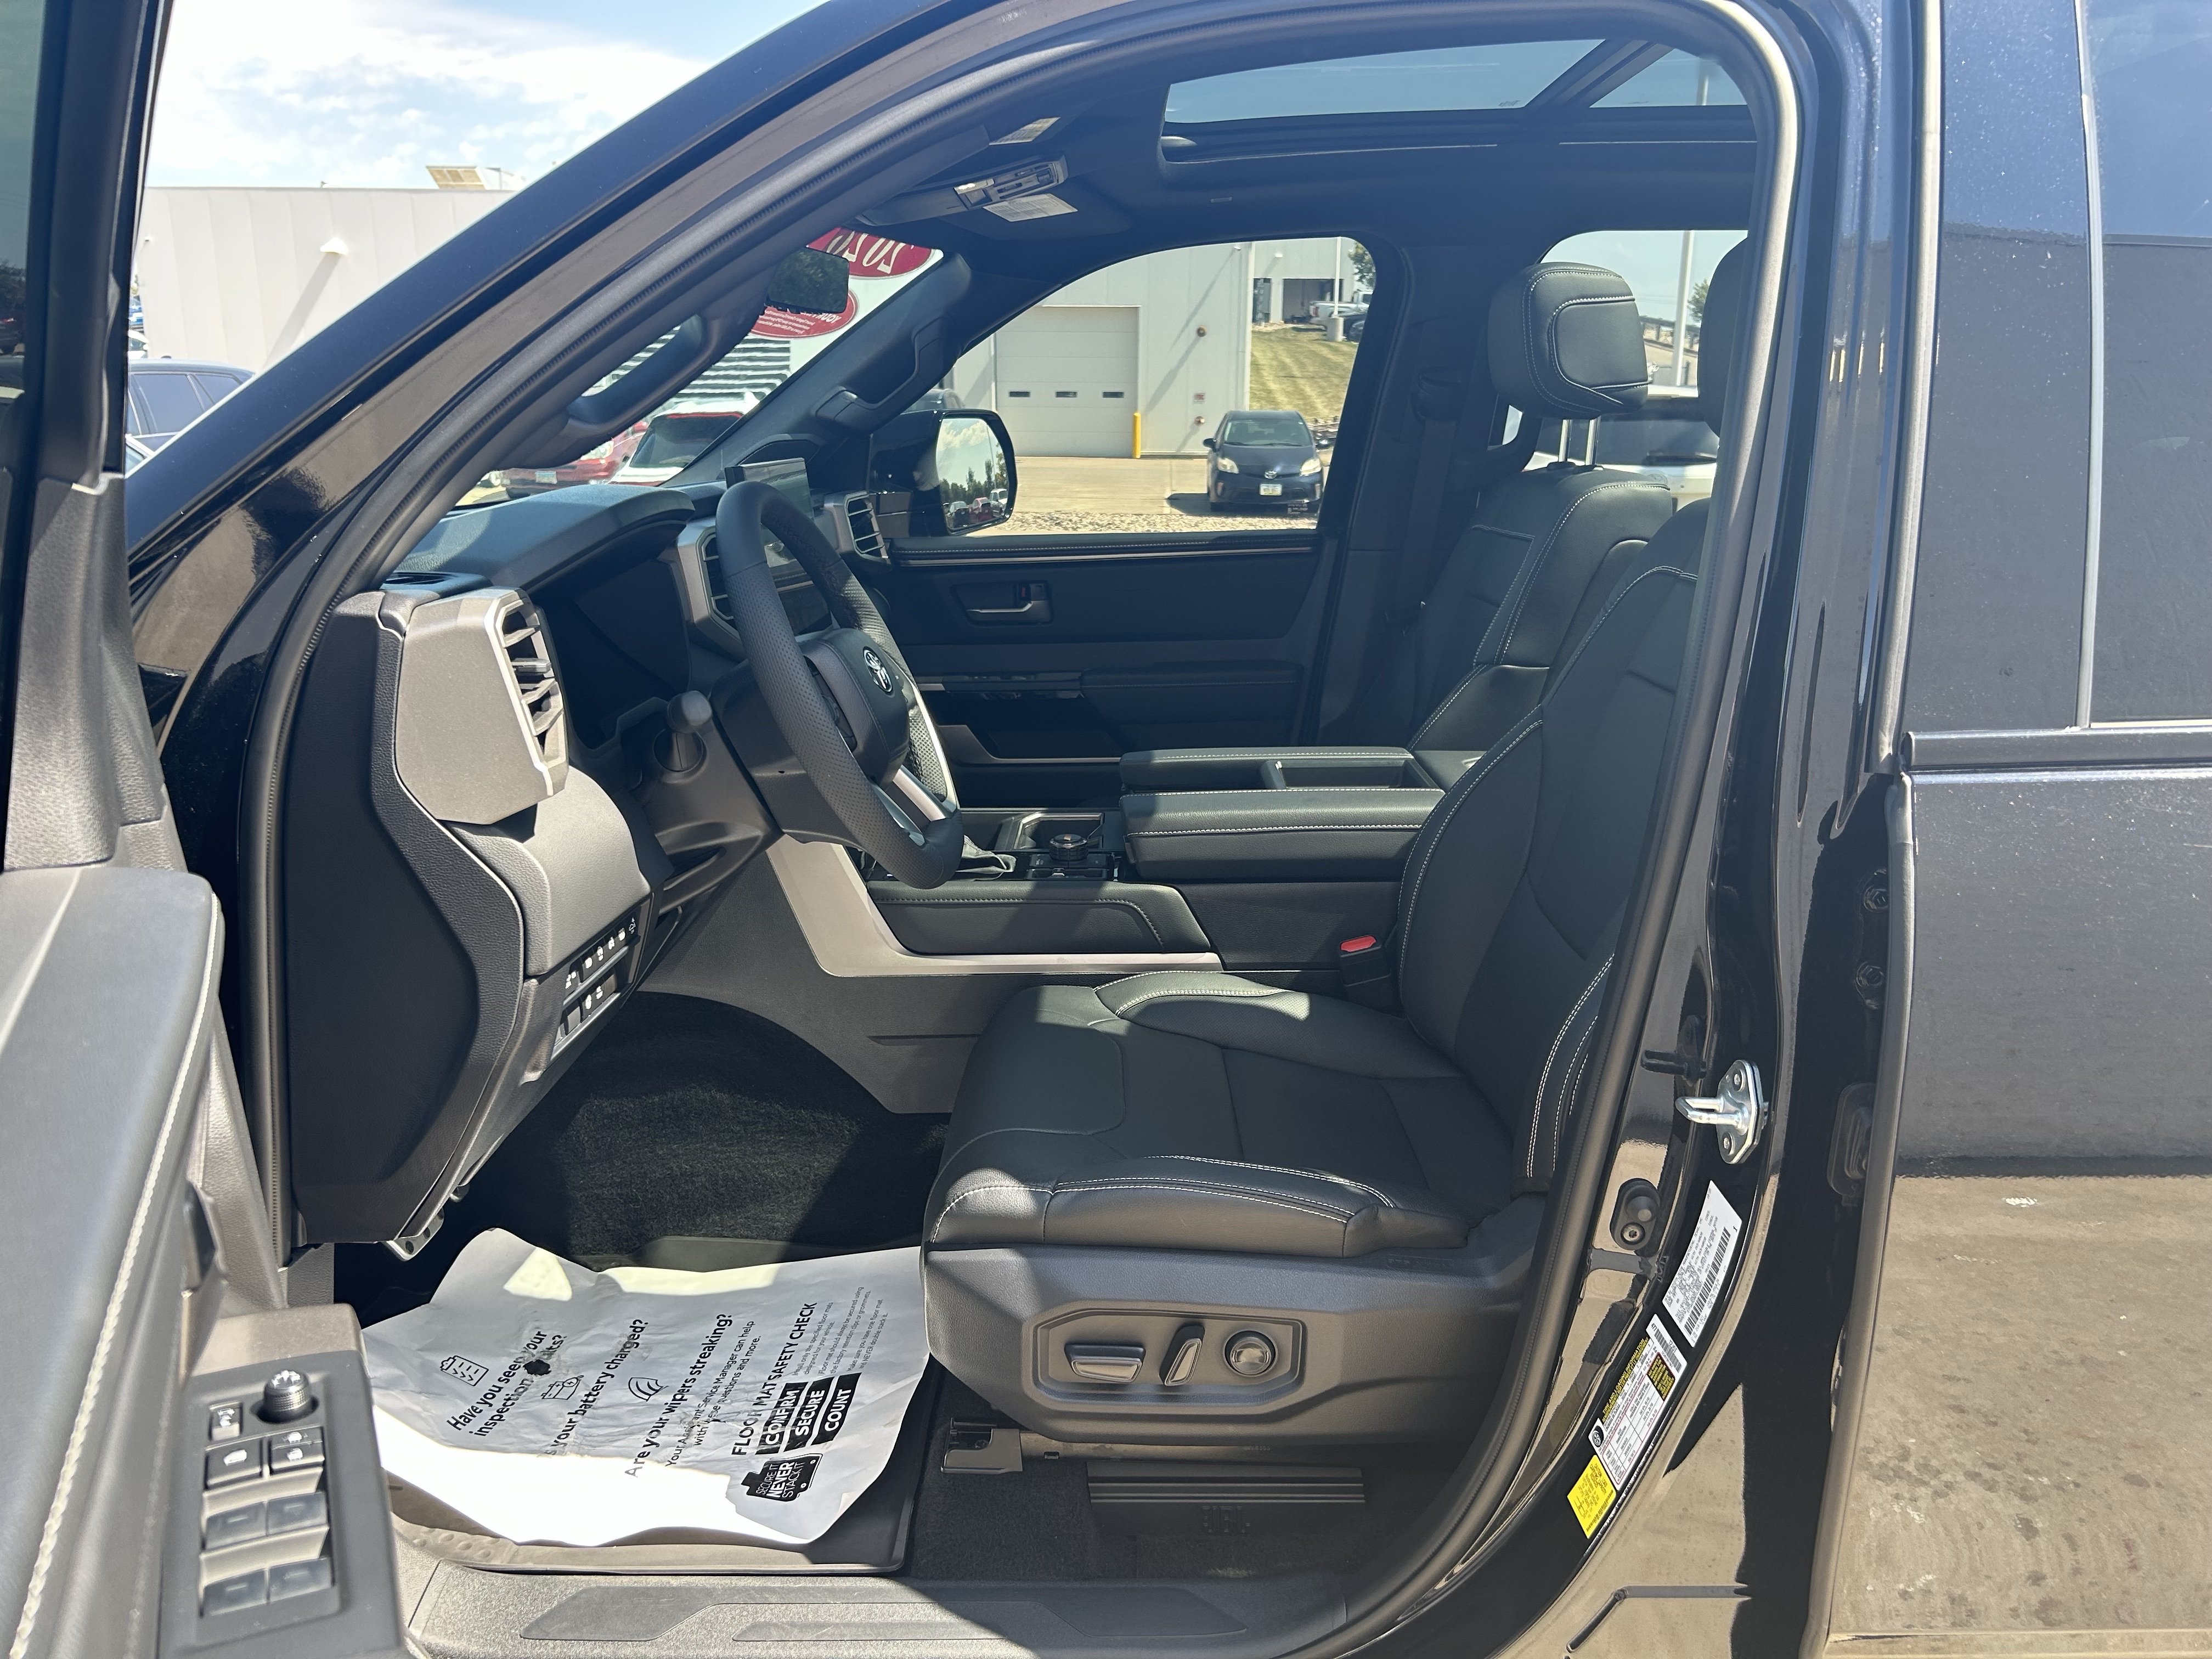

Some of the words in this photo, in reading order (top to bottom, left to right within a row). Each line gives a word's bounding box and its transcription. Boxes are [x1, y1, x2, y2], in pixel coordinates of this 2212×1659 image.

[731, 1407, 761, 1455] FLOOR
[753, 1381, 777, 1406] MAT
[768, 1342, 799, 1380] SAFETY
[789, 1302, 817, 1340] CHECK
[818, 1362, 828, 1374] Floor
[830, 1365, 839, 1374] the
[854, 1349, 862, 1359] sure
[862, 1346, 874, 1362] NEVER
[1613, 1370, 1627, 1393] LOADING
[1625, 1338, 1644, 1372] INFORMATION
[447, 1406, 483, 1430] Have
[476, 1385, 504, 1407] you
[498, 1357, 524, 1384] seen
[469, 1377, 534, 1436] inspection
[551, 1418, 577, 1448] your
[567, 1372, 614, 1416] battery
[605, 1319, 648, 1370] charged?
[624, 1450, 651, 1477] Are
[642, 1417, 669, 1448] your
[662, 1378, 697, 1414] wipers
[690, 1314, 732, 1375] streaking?
[665, 1443, 685, 1466] Your
[702, 1385, 718, 1408] Service
[714, 1353, 738, 1384] Manager
[733, 1335, 747, 1352] can
[742, 1321, 755, 1339] help
[694, 1426, 709, 1446] with
[737, 1358, 750, 1370] and
[745, 1335, 761, 1357] more.
[765, 1389, 800, 1444] CONFIRM
[795, 1390, 825, 1436] SECURE
[825, 1389, 851, 1431] COUNT
[755, 1471, 777, 1495] SECURE
[766, 1462, 795, 1498] NEVER
[782, 1468, 803, 1498] STACK
